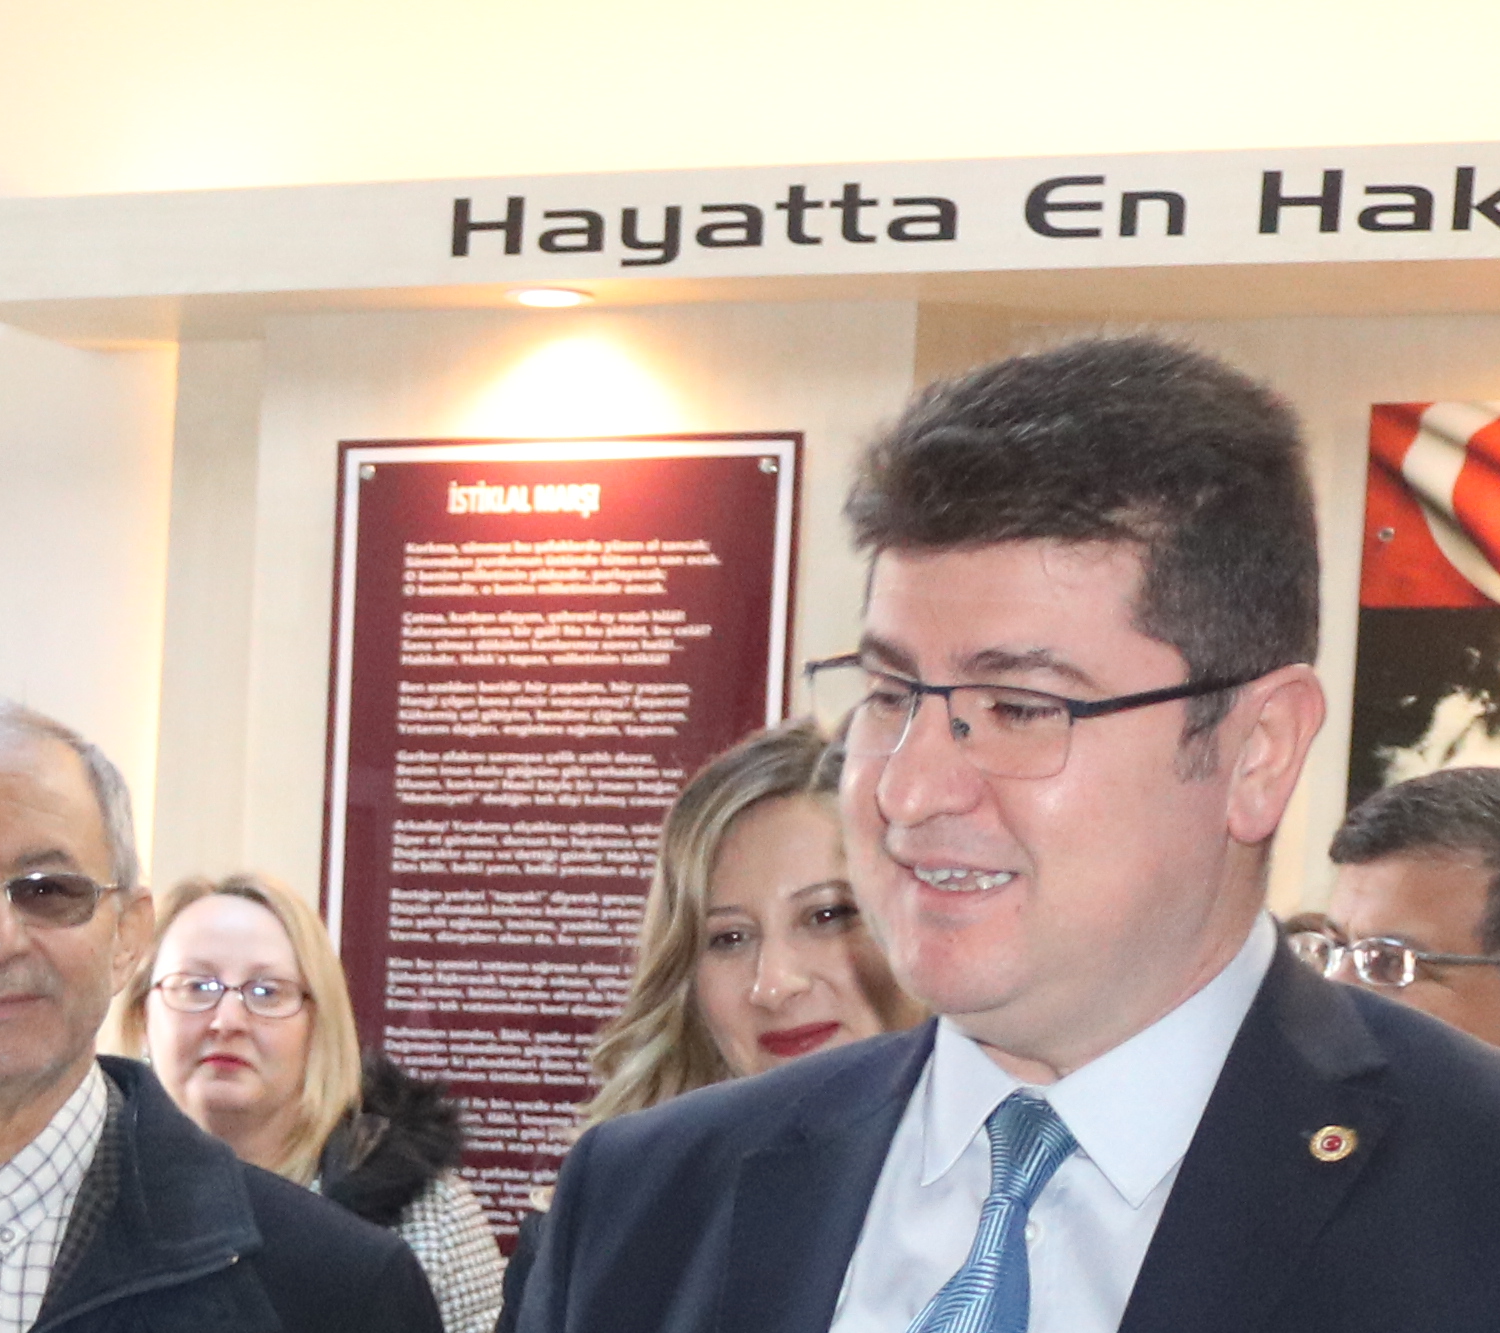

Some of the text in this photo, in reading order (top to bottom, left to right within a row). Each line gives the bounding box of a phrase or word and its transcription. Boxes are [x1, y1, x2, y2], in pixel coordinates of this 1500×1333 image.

[450, 183, 960, 269] Hayatta
[1024, 175, 1188, 240] En
[446, 479, 602, 519] İSTİKLAL MARŞI
